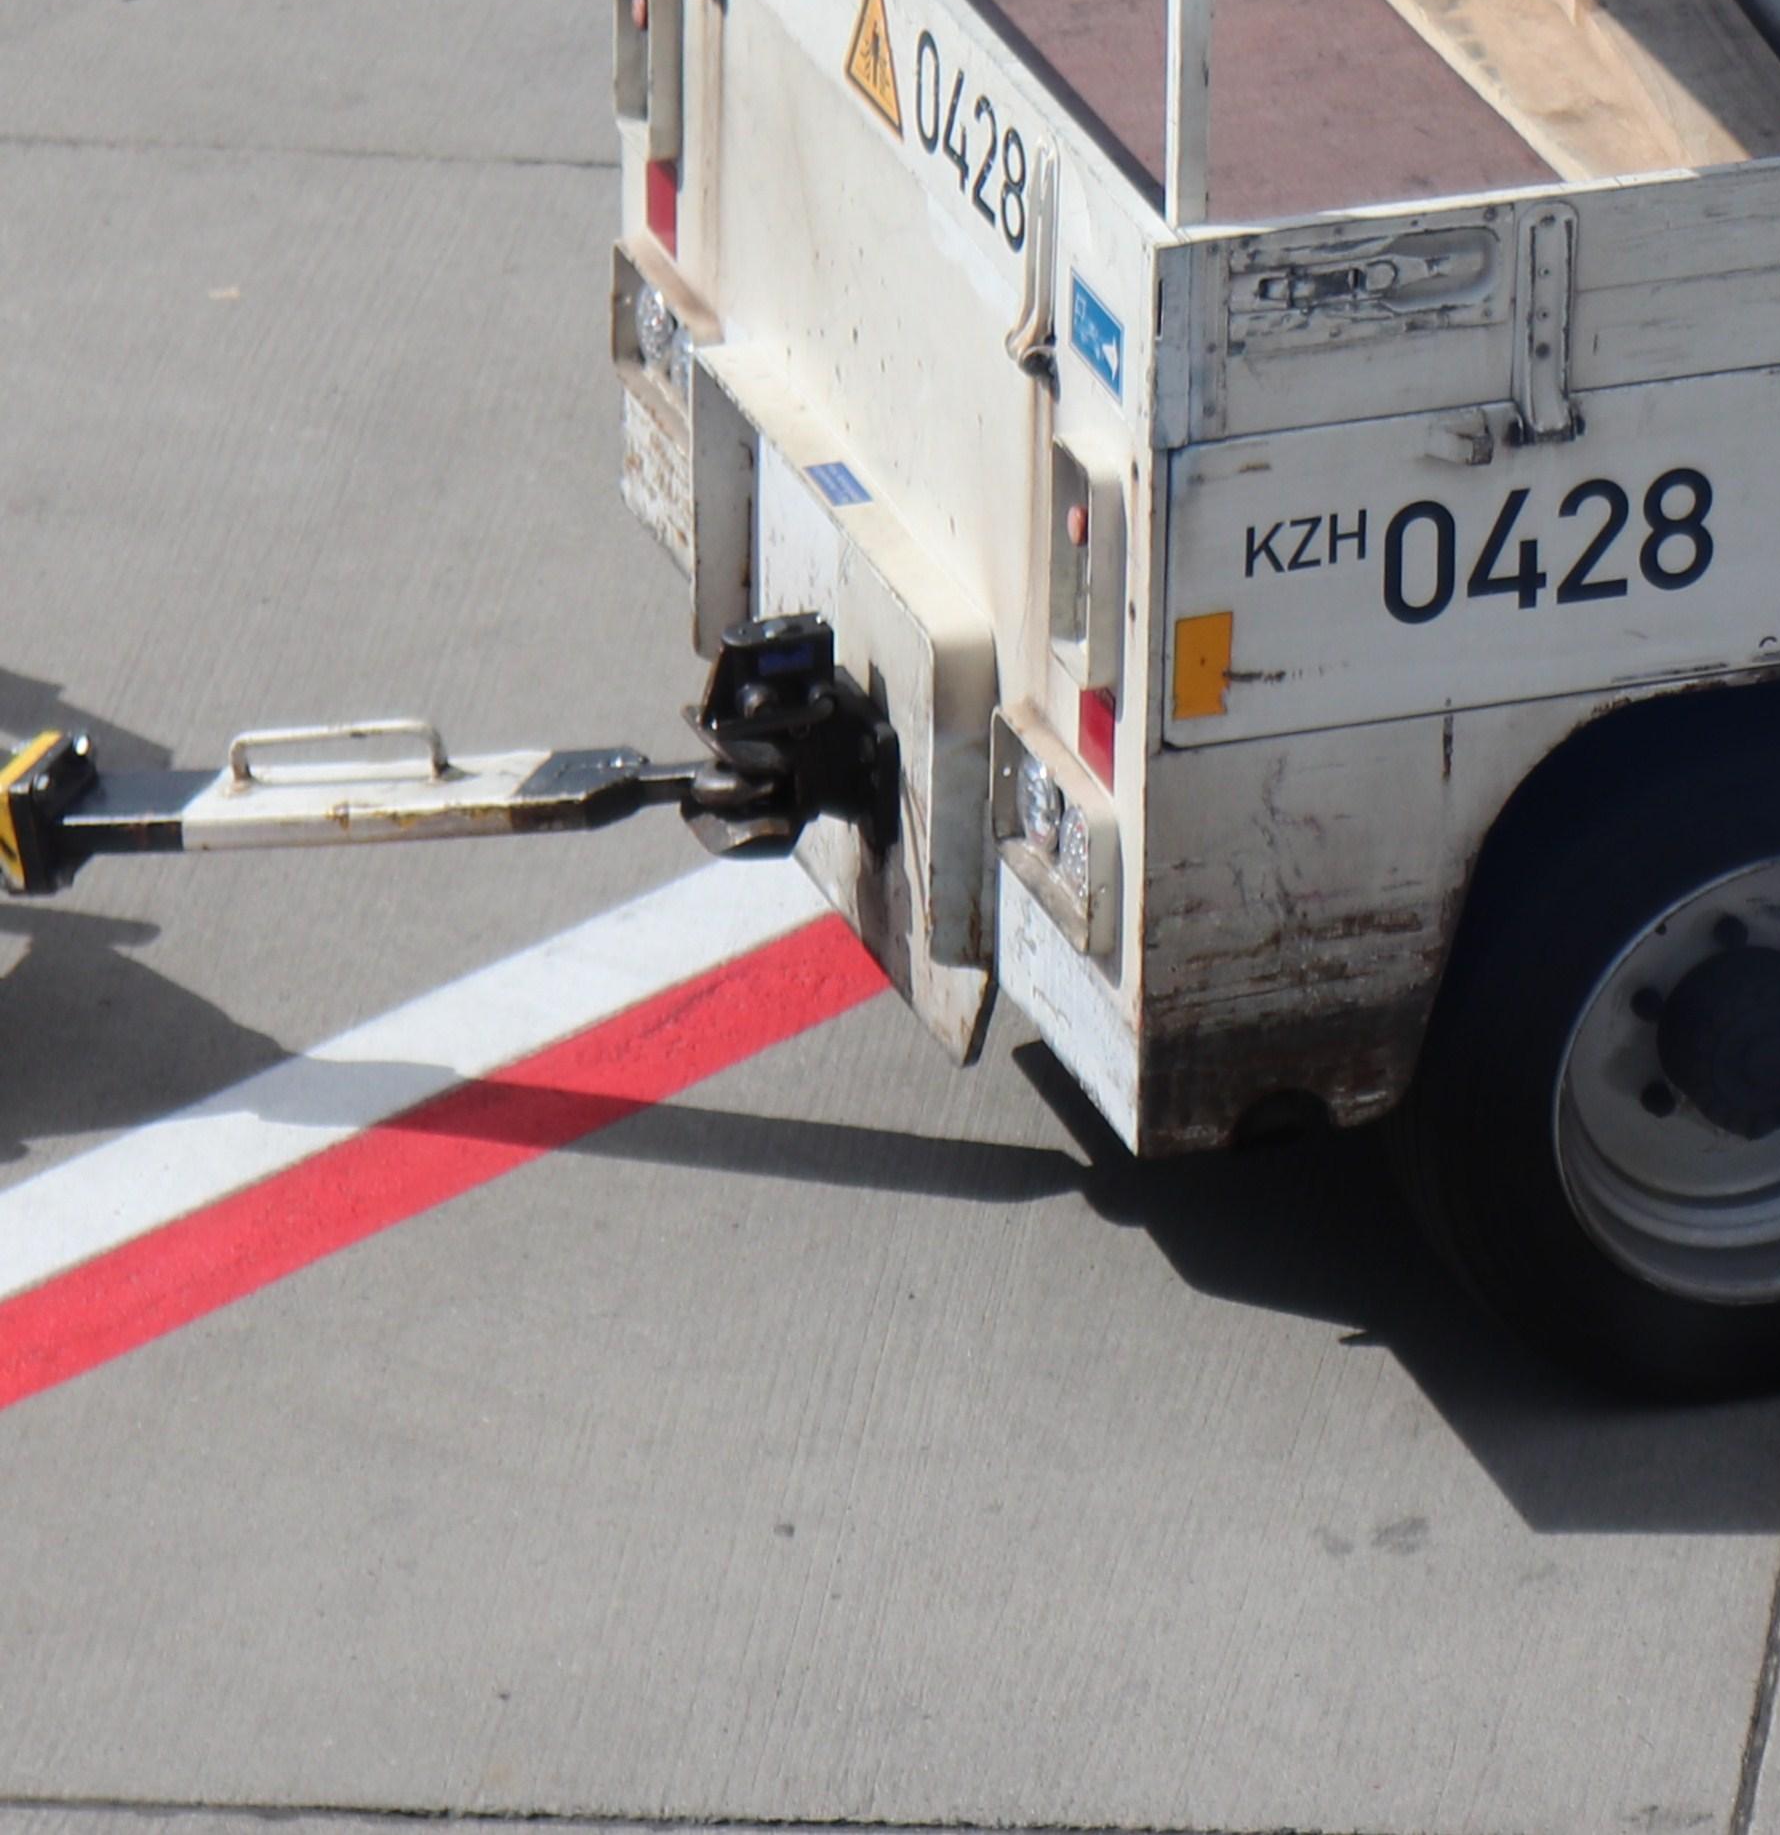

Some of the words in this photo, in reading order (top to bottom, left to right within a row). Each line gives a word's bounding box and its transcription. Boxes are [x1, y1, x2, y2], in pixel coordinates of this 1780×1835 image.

[914, 30, 1027, 253] 0428
[1244, 508, 1368, 578] KZH
[1383, 467, 1715, 625] 0428
